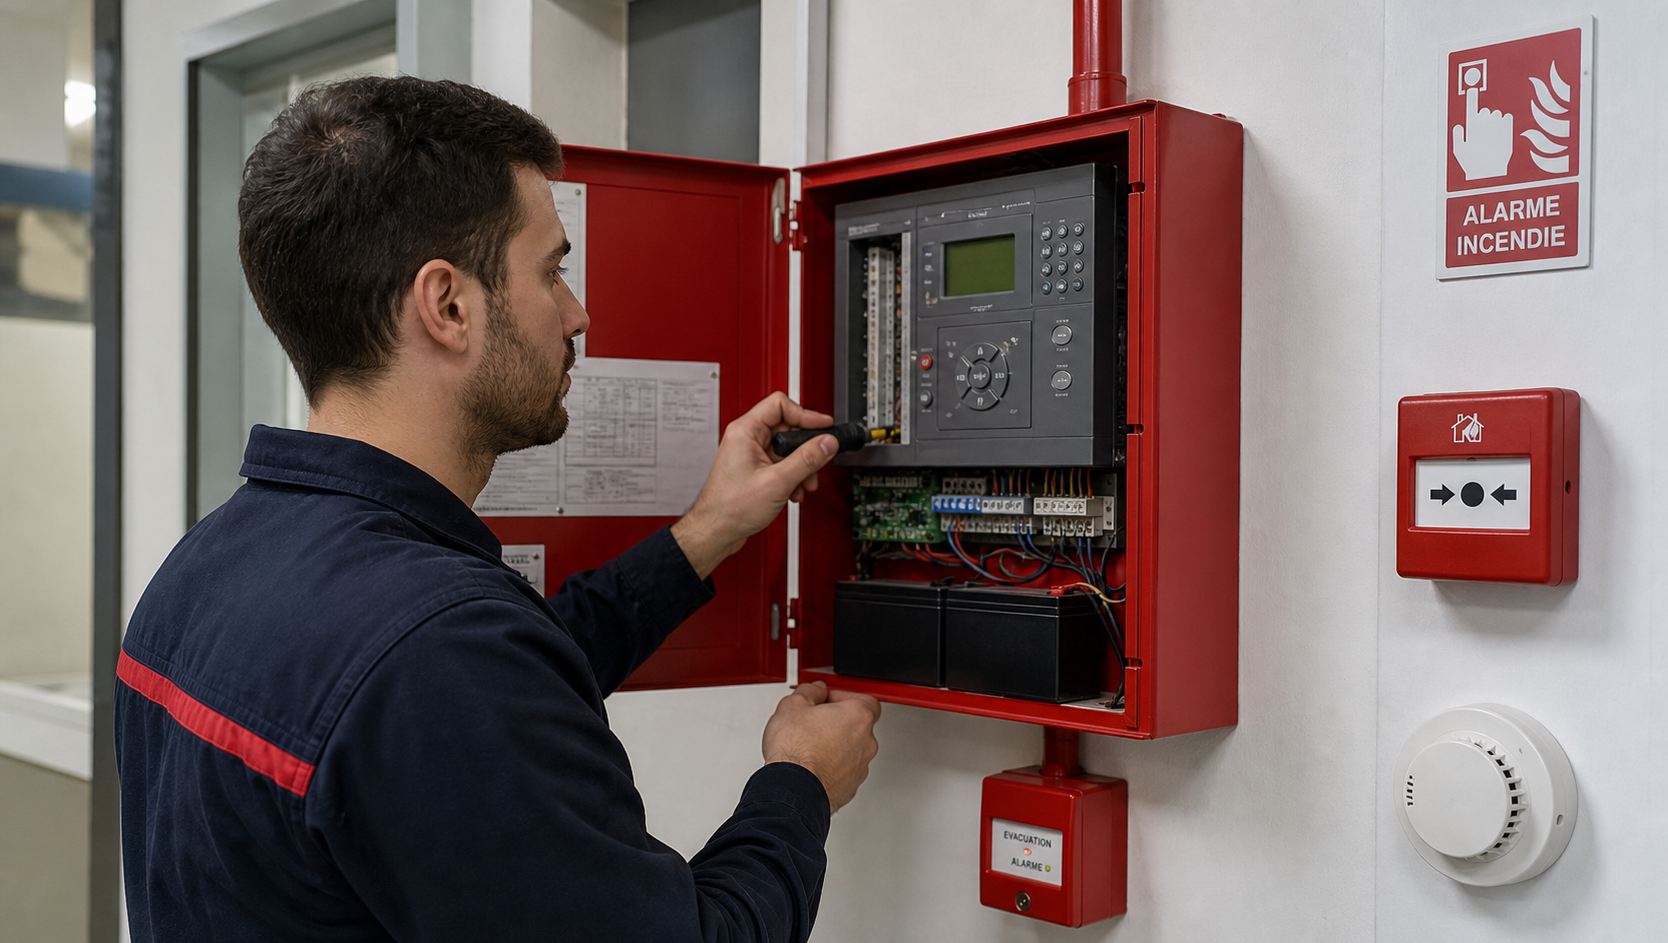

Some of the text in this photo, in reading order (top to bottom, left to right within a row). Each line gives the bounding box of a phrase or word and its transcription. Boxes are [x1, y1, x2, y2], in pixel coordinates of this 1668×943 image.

[1463, 196, 1560, 226] ALARME
[1457, 225, 1565, 256] INCENDIE
[1003, 831, 1052, 848] EVACUATION
[1011, 857, 1043, 872] ALARME
